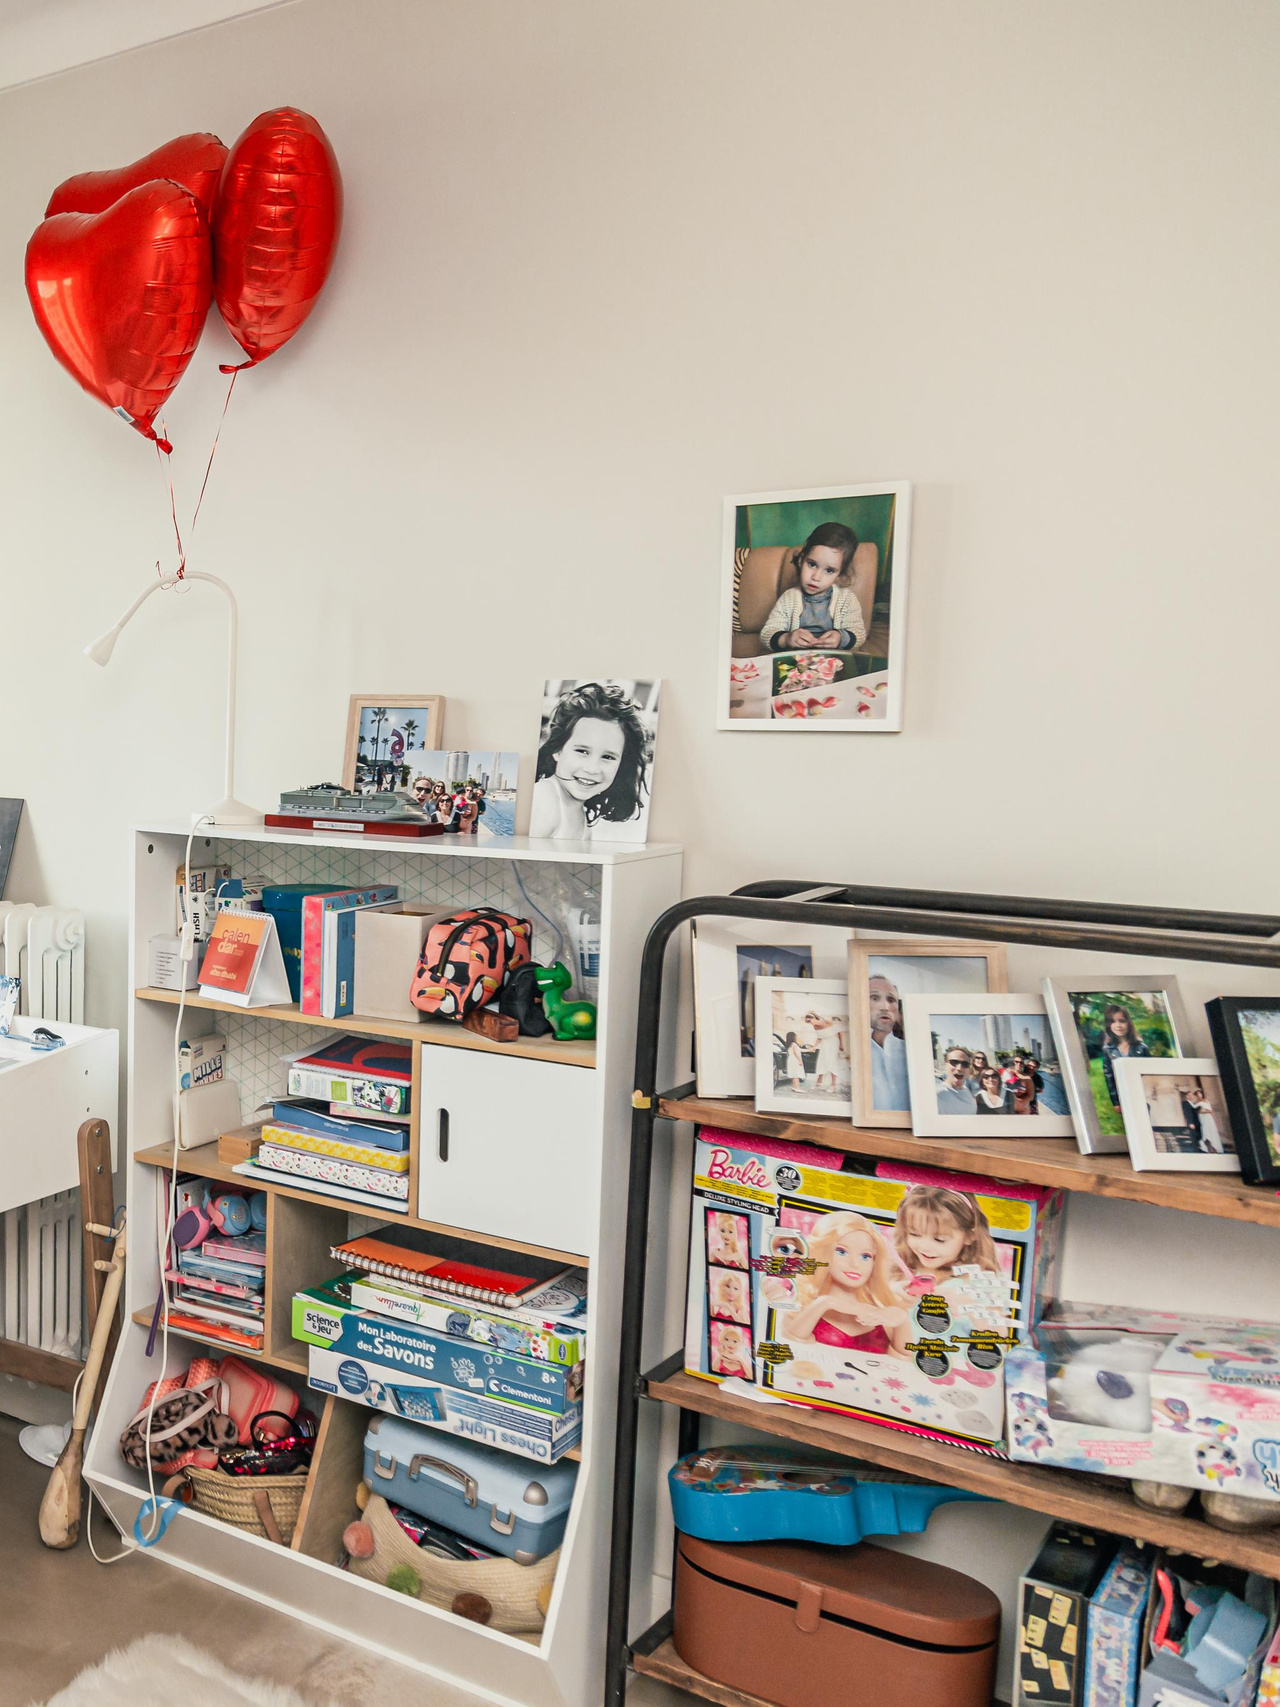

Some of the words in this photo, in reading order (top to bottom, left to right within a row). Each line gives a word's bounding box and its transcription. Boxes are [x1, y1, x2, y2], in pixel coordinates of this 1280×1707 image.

[218, 938, 238, 954] dar
[222, 928, 250, 943] calen
[193, 1055, 222, 1082] MILLE
[708, 1148, 773, 1188] Barbie
[780, 1168, 796, 1179] 30
[704, 1192, 726, 1203] DELUXE
[727, 1198, 751, 1211] STYLING
[753, 1204, 769, 1213] HEAD
[372, 1295, 424, 1321] Aquarellum
[306, 1312, 339, 1329] science
[317, 1324, 331, 1335] jeu
[358, 1322, 379, 1336] Mon
[380, 1328, 436, 1353] Laboratoire
[357, 1340, 372, 1353] des
[373, 1338, 434, 1370] Savons
[541, 1372, 557, 1384] 8+
[501, 1384, 552, 1405] Clementoni
[501, 1432, 547, 1457] Chess
